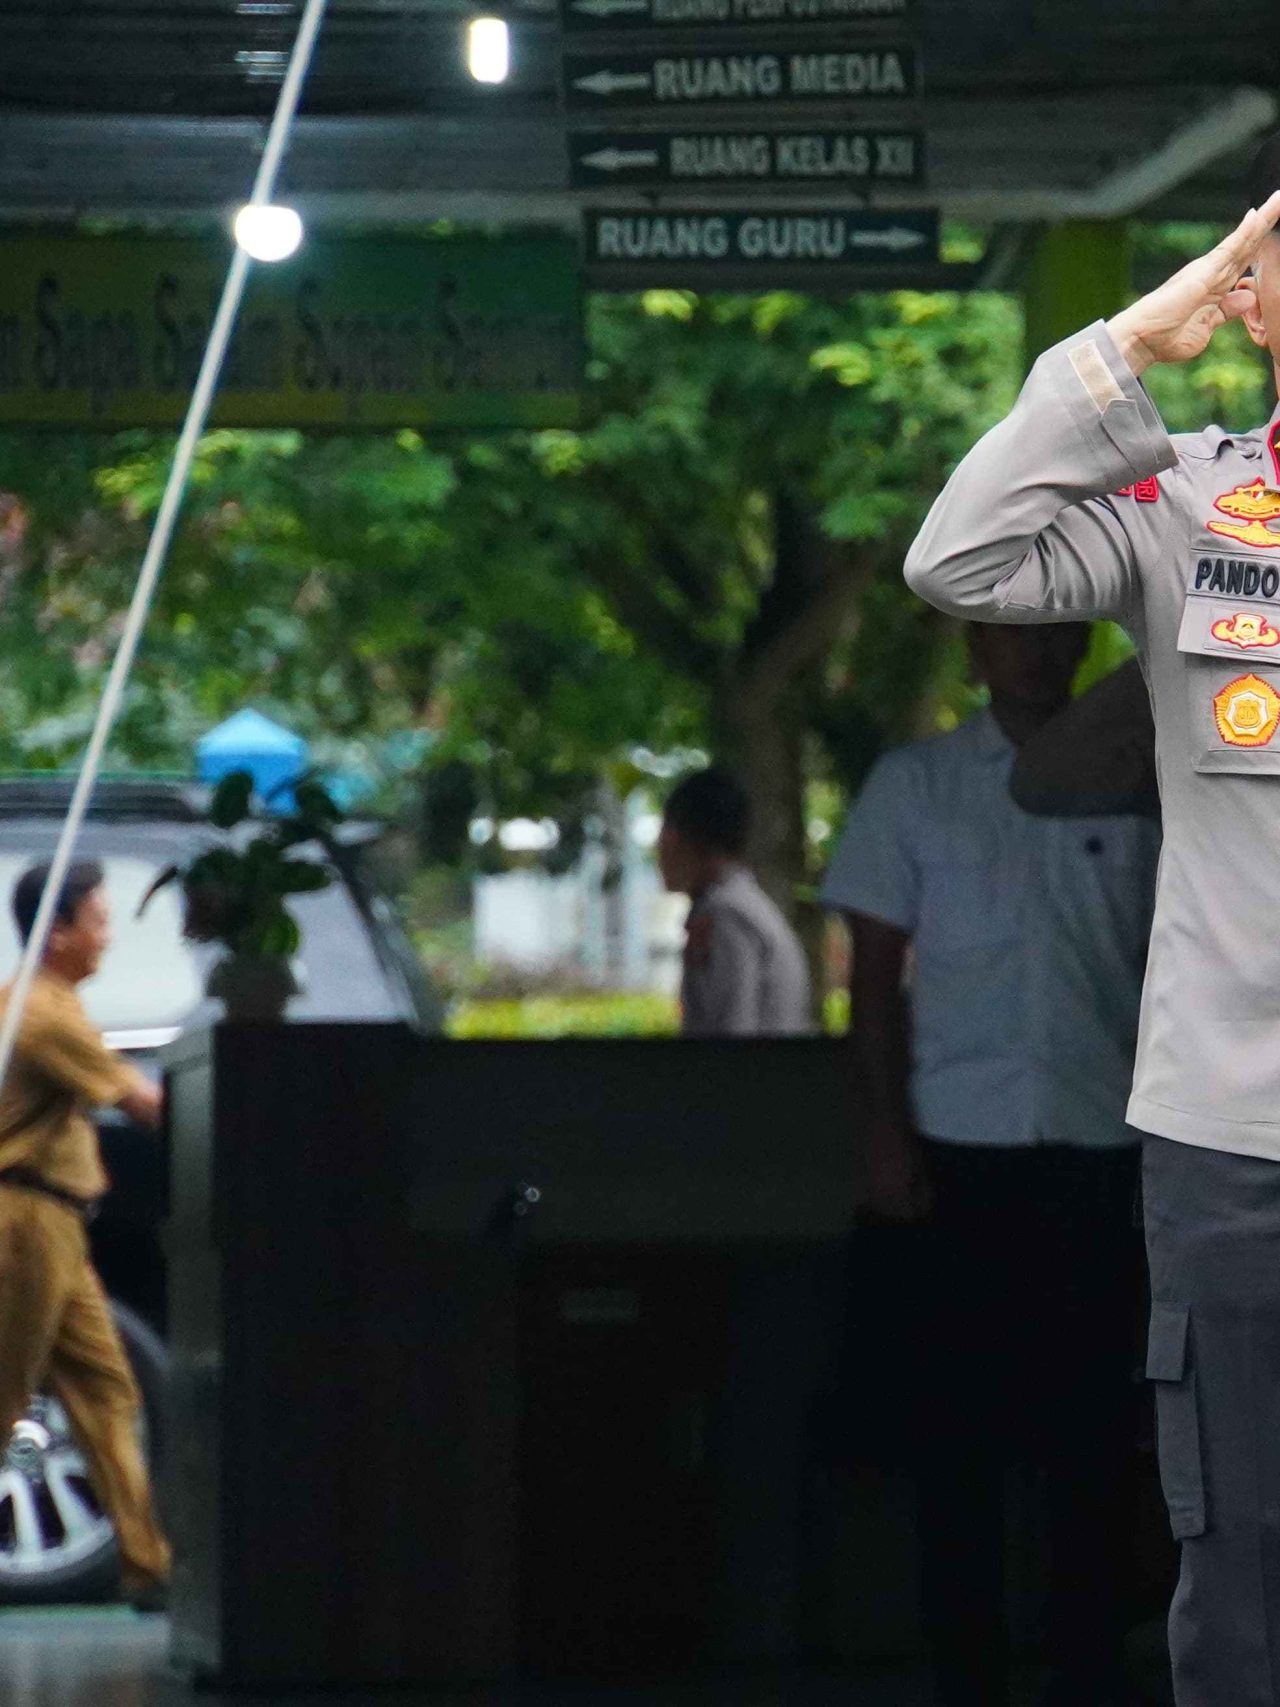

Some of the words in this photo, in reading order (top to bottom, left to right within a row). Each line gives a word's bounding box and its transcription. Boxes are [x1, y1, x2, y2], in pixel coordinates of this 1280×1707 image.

[654, 56, 781, 98] RUANG
[790, 53, 905, 94] MEDIA
[669, 136, 771, 177] RUANG
[776, 135, 870, 176] KELAS
[596, 217, 729, 258] RUANG
[738, 216, 847, 259] GURU
